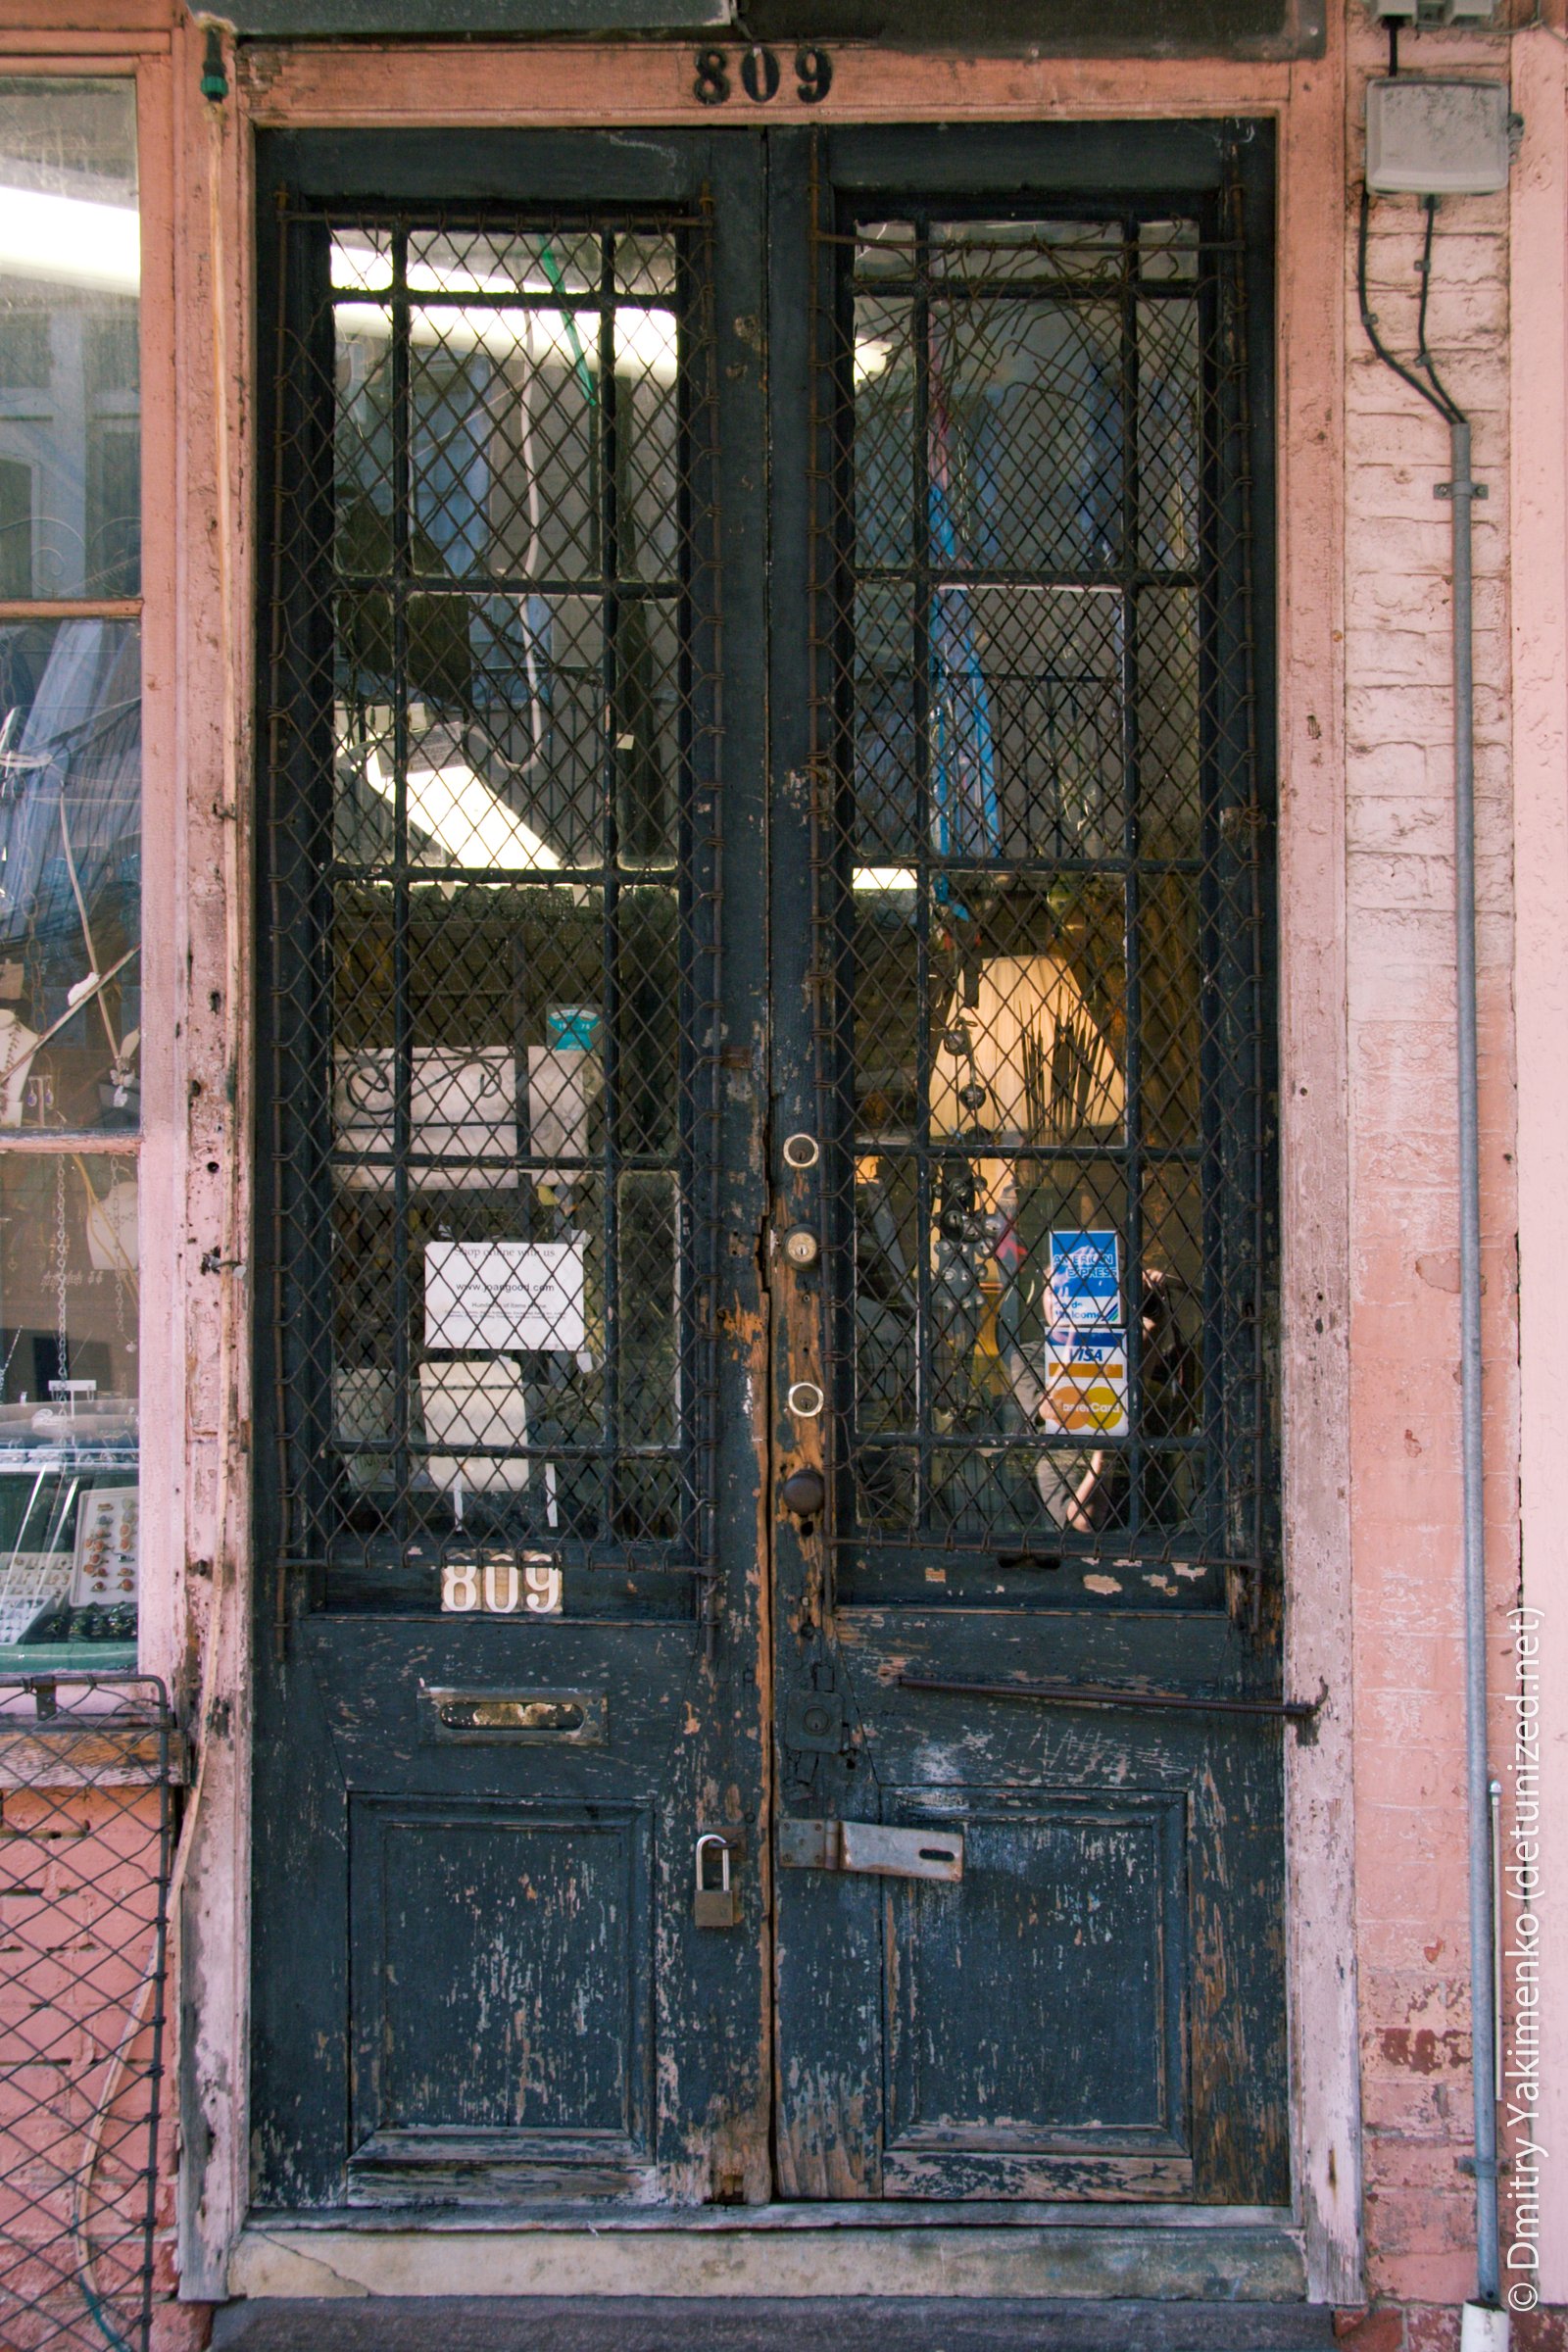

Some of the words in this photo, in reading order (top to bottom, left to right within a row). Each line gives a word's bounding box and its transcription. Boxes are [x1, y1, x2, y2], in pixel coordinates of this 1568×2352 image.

[694, 47, 832, 105] 809
[1069, 1348, 1102, 1361] VISA
[1054, 1402, 1120, 1413] asterCard
[443, 1553, 560, 1613] 809
